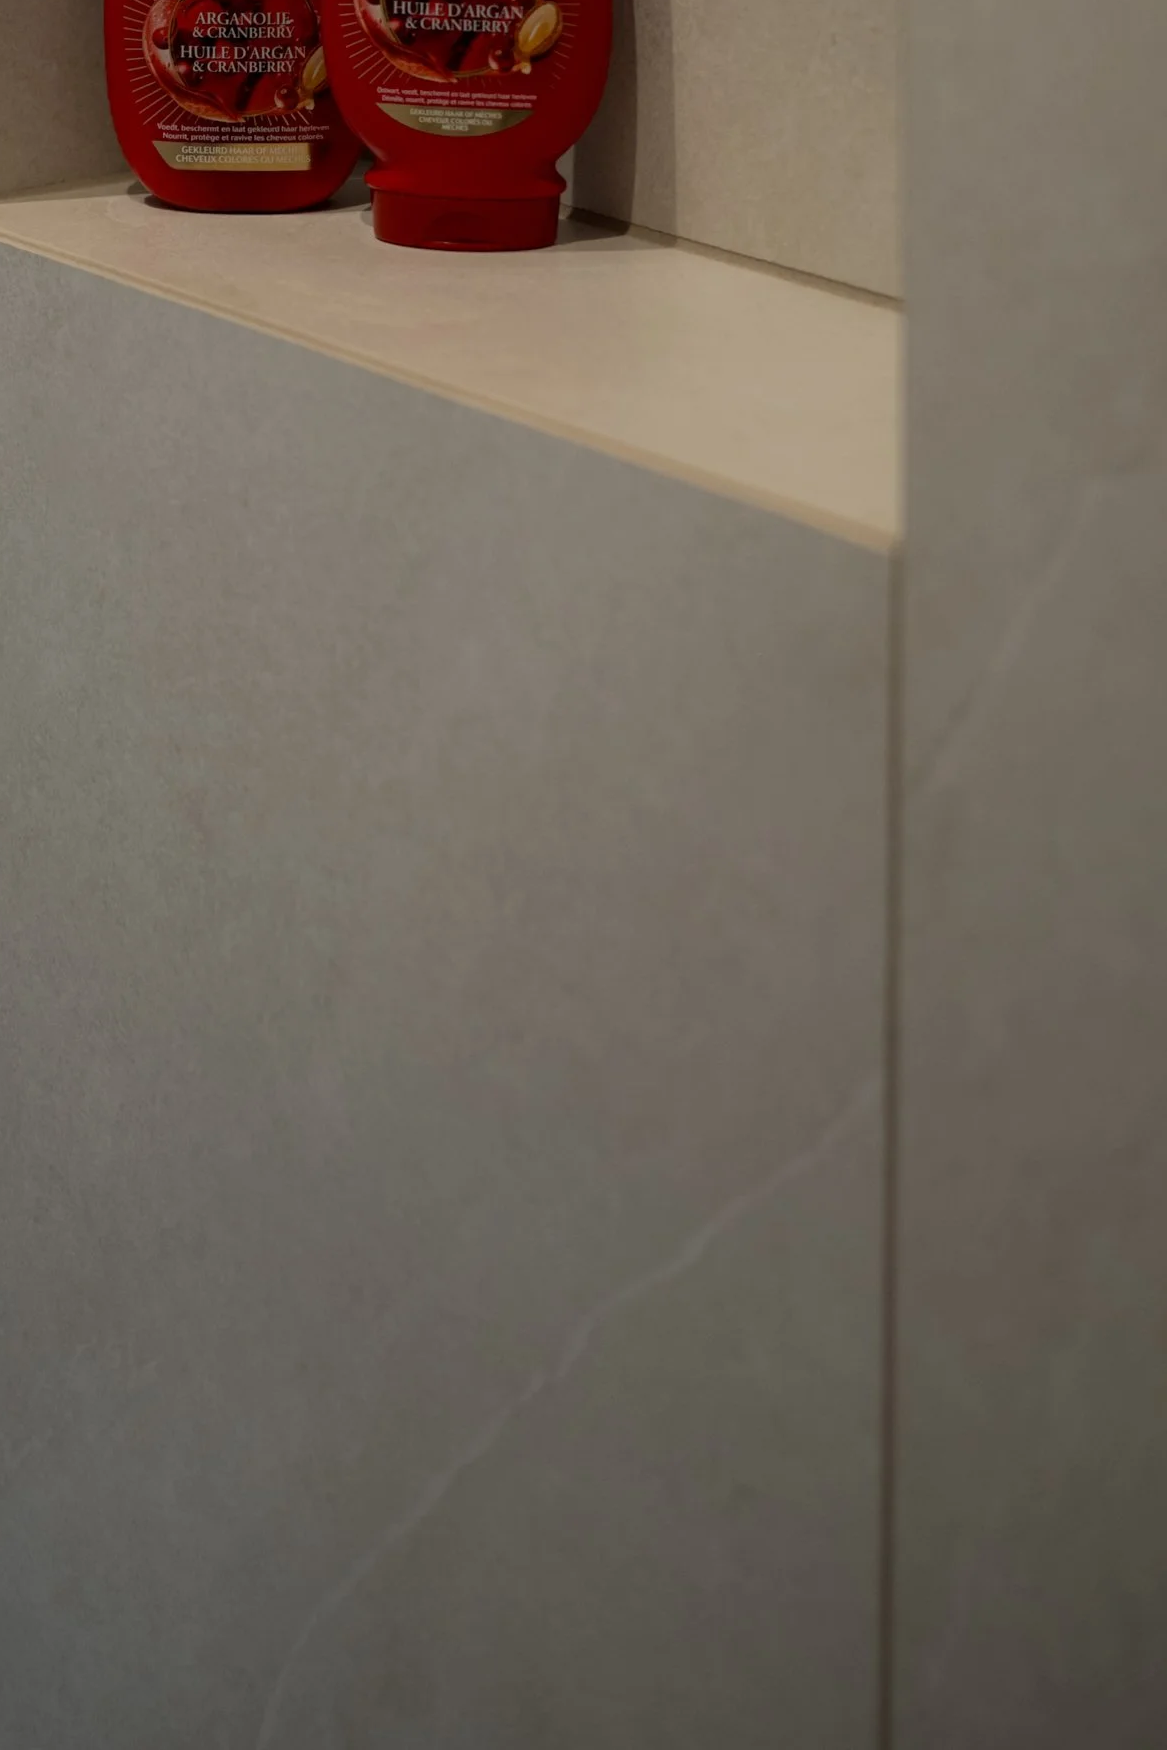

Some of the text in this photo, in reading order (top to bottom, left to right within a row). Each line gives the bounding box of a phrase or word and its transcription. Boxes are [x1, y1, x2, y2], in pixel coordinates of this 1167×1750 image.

[392, 0, 524, 20] HUILE D'ARGAN
[195, 11, 291, 26] ARGANOLIE
[405, 17, 512, 33] & CRANBERRY
[192, 26, 295, 39] & CRANBERRY
[180, 45, 306, 60] HUILE D'ARGAN
[192, 60, 295, 73] & CRANBERRY
[232, 125, 246, 133] laat
[247, 125, 280, 134] gekleurd
[281, 125, 297, 133] haar
[254, 134, 265, 142] les
[181, 145, 227, 154] GEKLEURD
[175, 154, 216, 163] CHEVEUX
